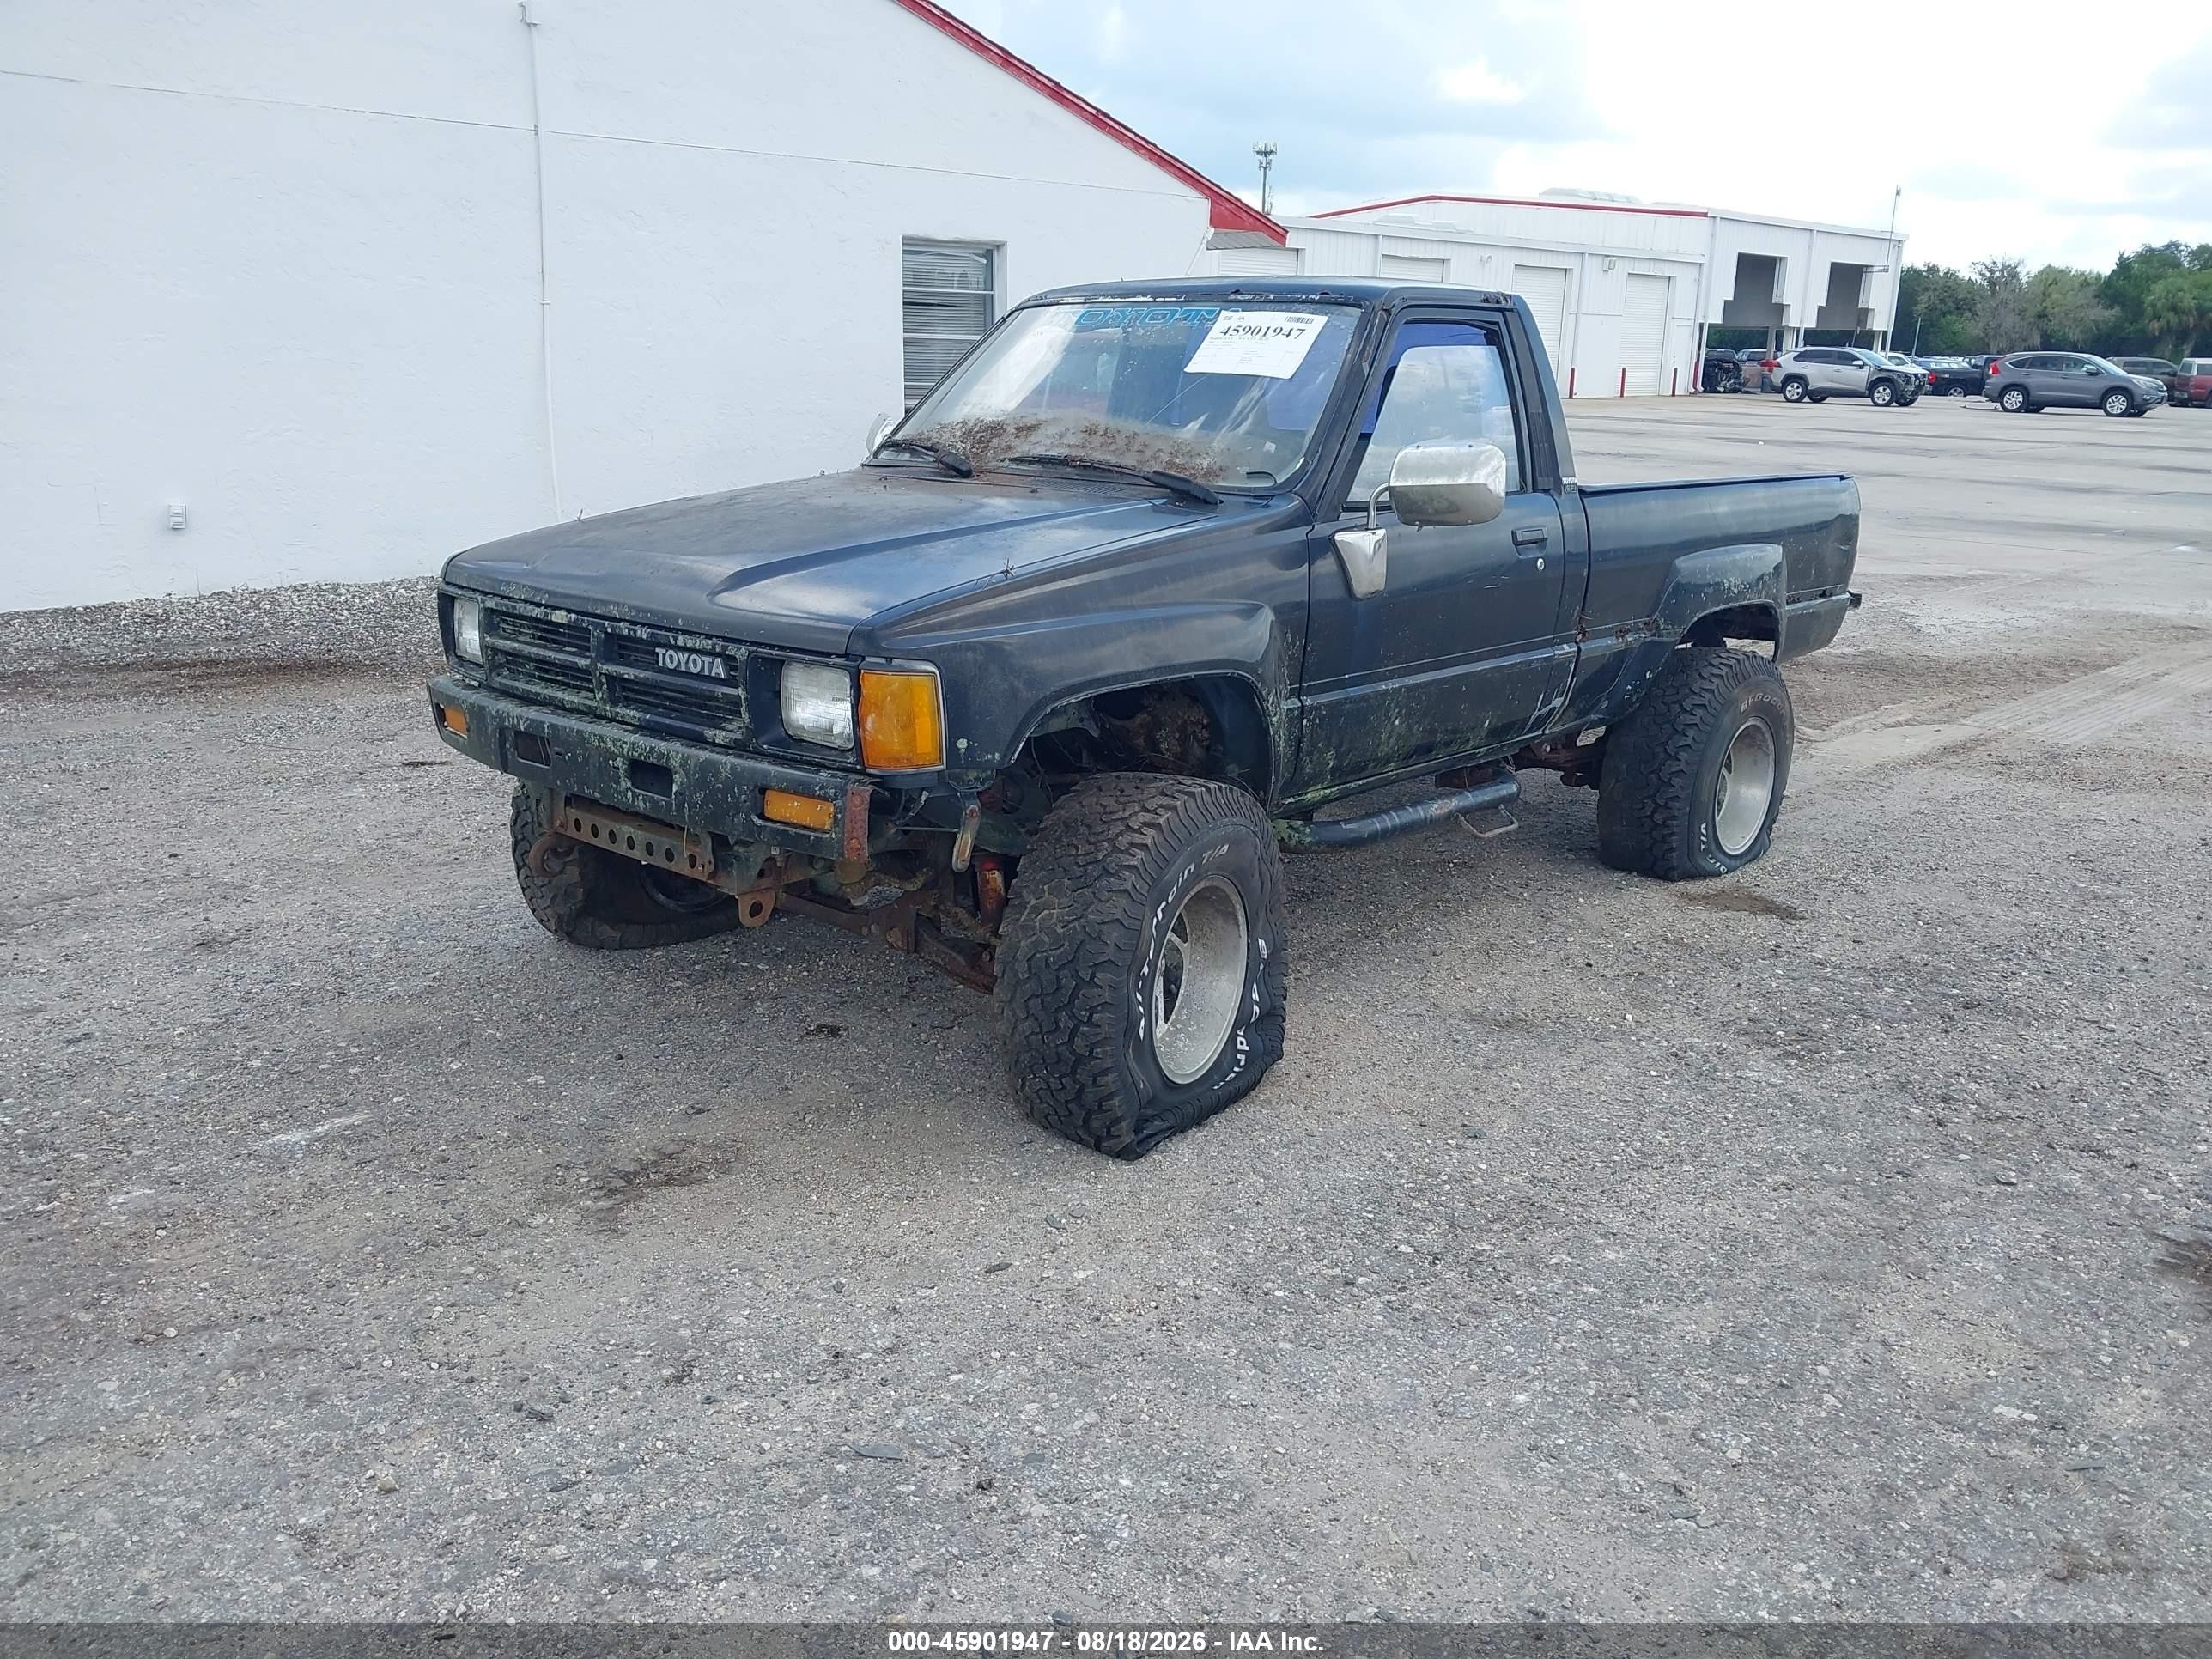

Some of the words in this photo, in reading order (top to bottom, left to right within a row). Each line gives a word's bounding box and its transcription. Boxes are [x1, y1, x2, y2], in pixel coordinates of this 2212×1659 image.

[1219, 325, 1306, 340] 45901947
[655, 647, 726, 678] TOYOTA
[1202, 844, 1230, 865] T/A
